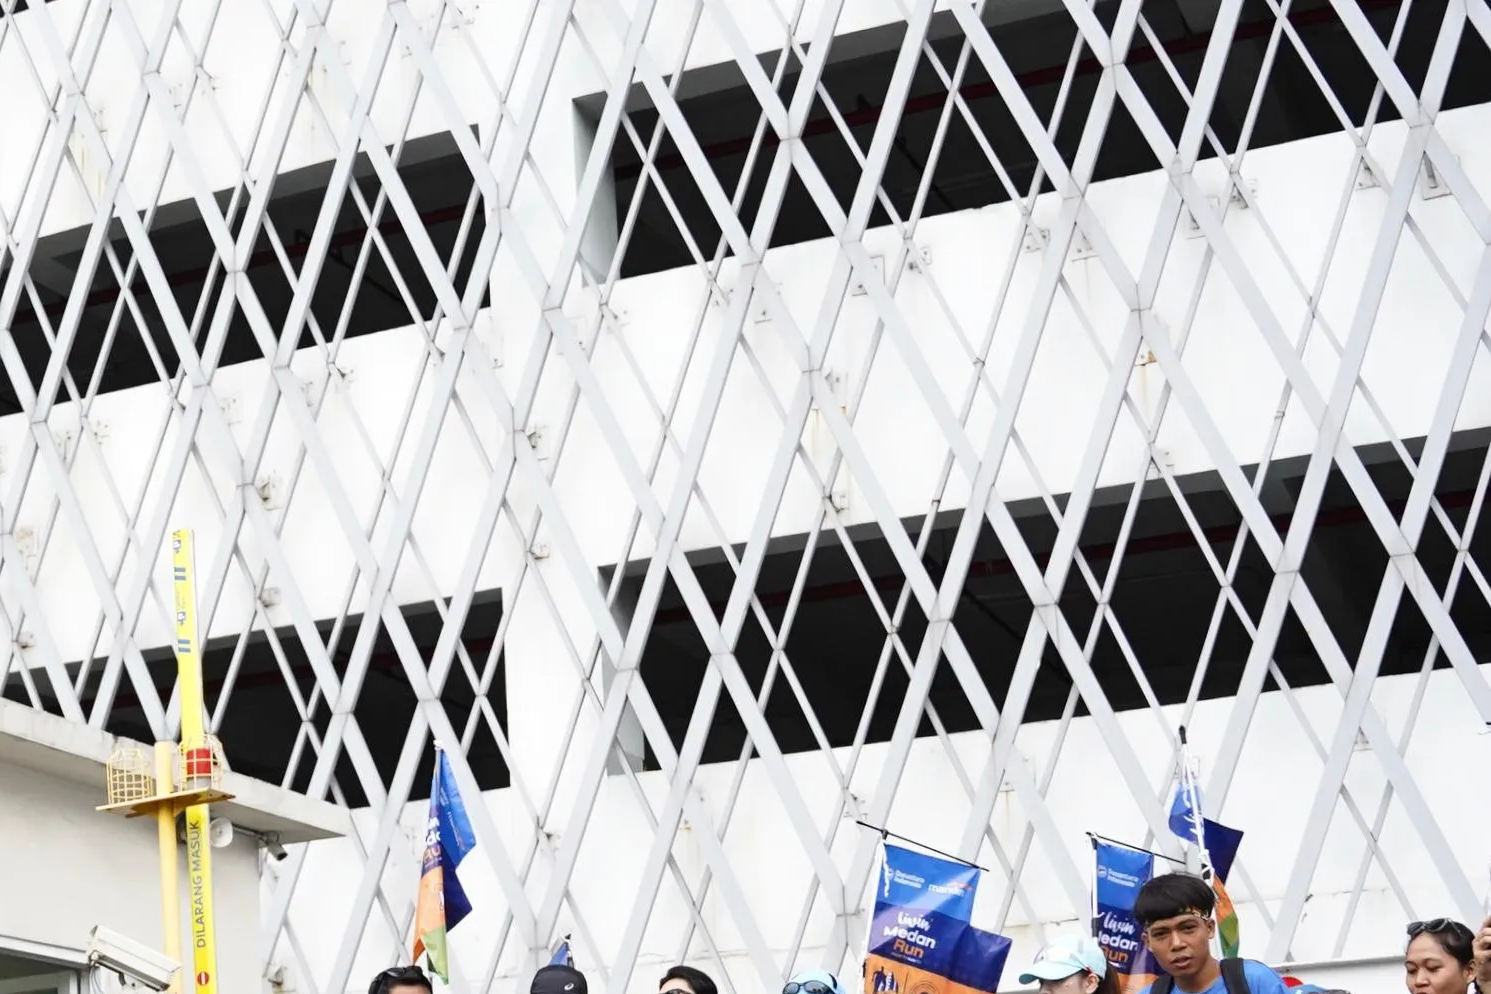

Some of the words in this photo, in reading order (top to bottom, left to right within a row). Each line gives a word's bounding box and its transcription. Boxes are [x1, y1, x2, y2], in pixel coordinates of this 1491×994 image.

[189, 819, 201, 872] MASUK
[192, 874, 206, 948] DILARANG
[883, 926, 936, 949] Medan
[893, 938, 925, 959] Run
